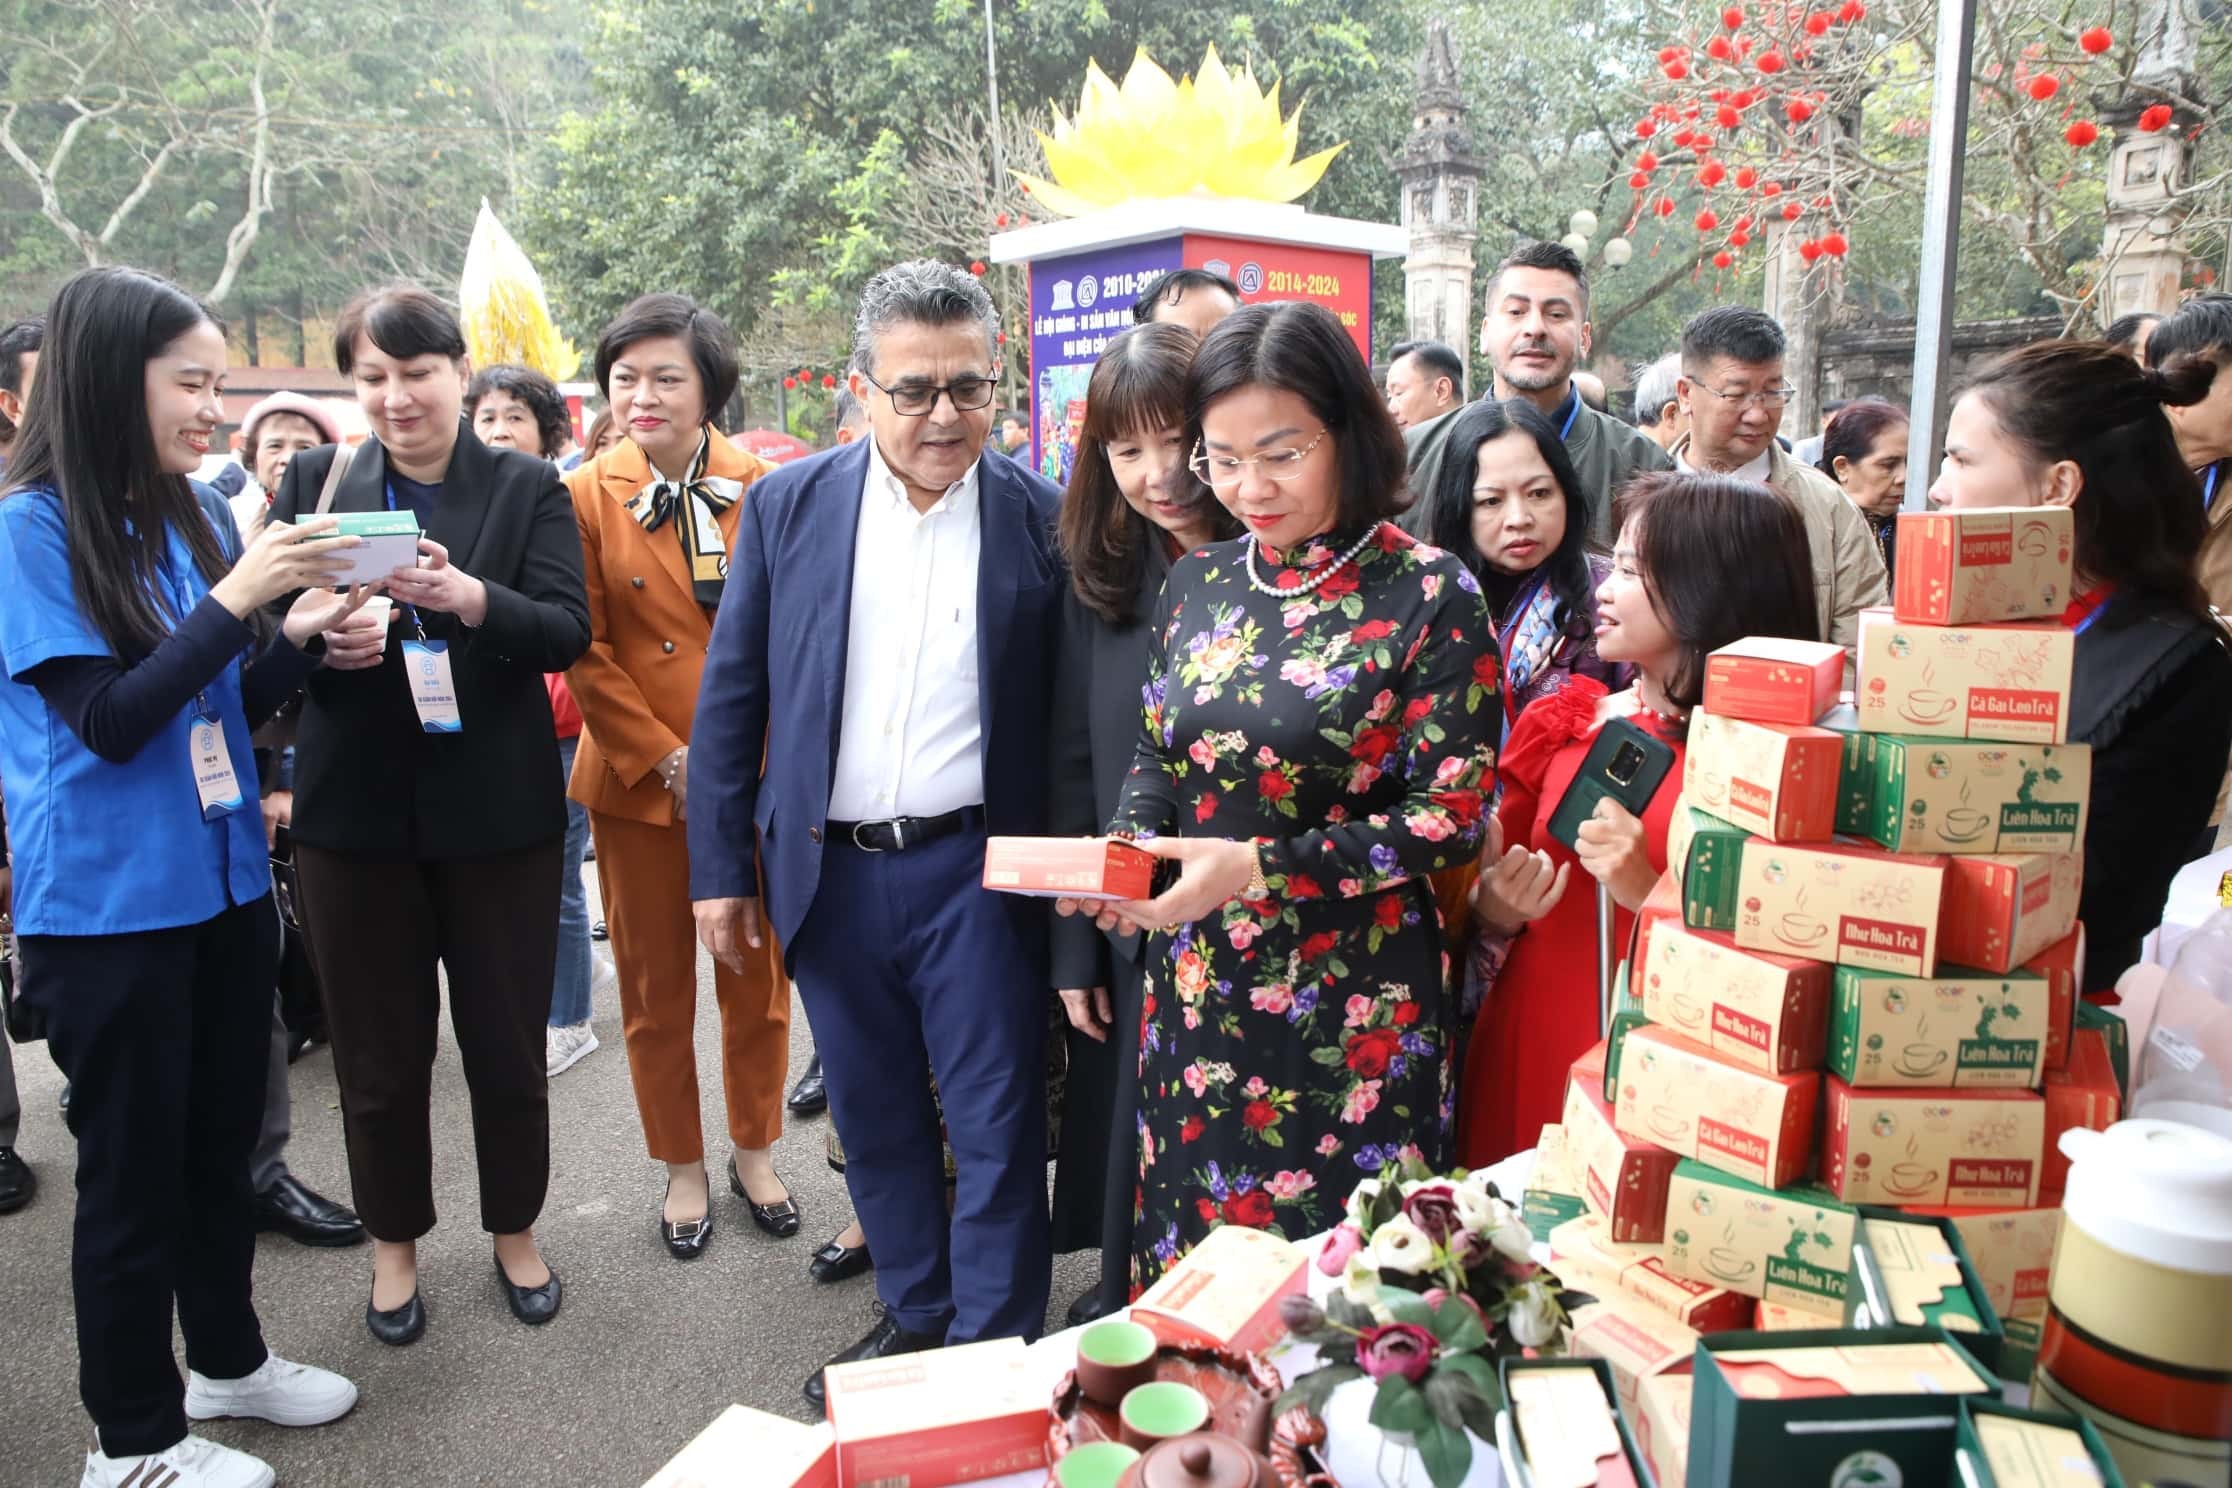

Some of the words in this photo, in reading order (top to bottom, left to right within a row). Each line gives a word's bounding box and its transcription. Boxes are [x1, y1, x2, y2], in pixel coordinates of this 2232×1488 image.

[1103, 268, 1165, 298] 2010-20
[1268, 271, 1340, 296] 2014-2024
[1867, 696, 1886, 708] 25
[1970, 695, 1986, 713] Cà
[1978, 751, 2007, 761] OCOP
[1908, 819, 1925, 830] 25
[2002, 807, 2028, 825] Liên
[2029, 809, 2050, 825] Hoa
[2053, 808, 2076, 826] Trà
[1743, 914, 1761, 926] 25
[1871, 928, 1893, 945] Hoa
[1895, 930, 1919, 950] Trà
[1865, 1053, 1882, 1064] 25
[1961, 1044, 1987, 1062] Liên
[1989, 1046, 2011, 1062] Hoa
[2014, 1044, 2034, 1063] Trà
[1853, 1172, 1870, 1183] 25
[1982, 1167, 2002, 1183] Hoa
[2004, 1165, 2025, 1183] Trà
[1672, 1246, 1688, 1258] 25
[1769, 1260, 1796, 1283] Liên
[1797, 1266, 1823, 1289] Hoa
[1825, 1269, 1847, 1294] Trà
